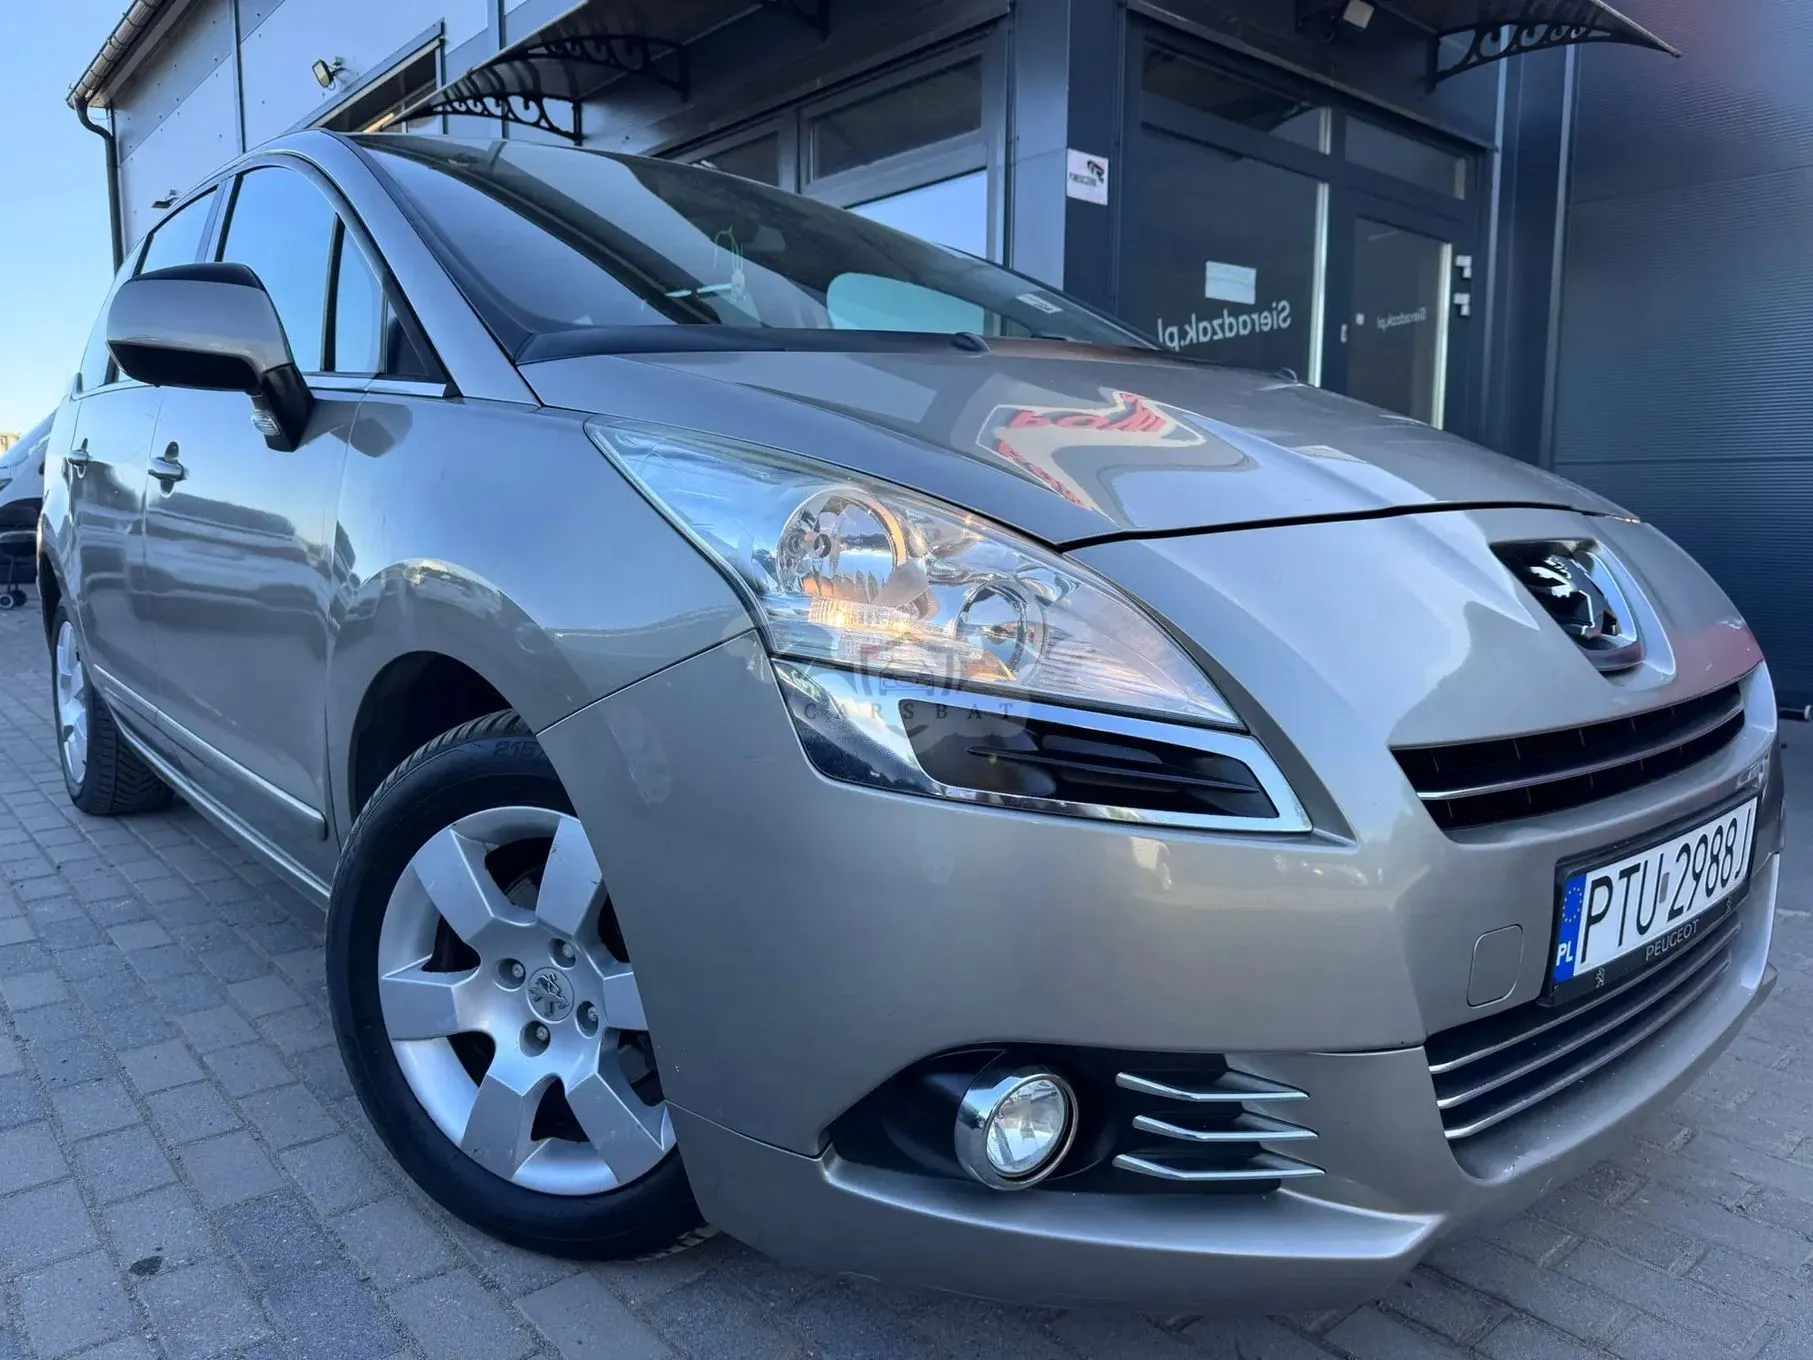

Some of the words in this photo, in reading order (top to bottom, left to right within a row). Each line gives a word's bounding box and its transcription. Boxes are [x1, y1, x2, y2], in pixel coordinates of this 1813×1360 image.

[1580, 853, 1664, 965] PTU
[1667, 807, 1752, 923] 2988J
[1555, 940, 1574, 967] PL
[1645, 919, 1701, 961] PEUGEOT
